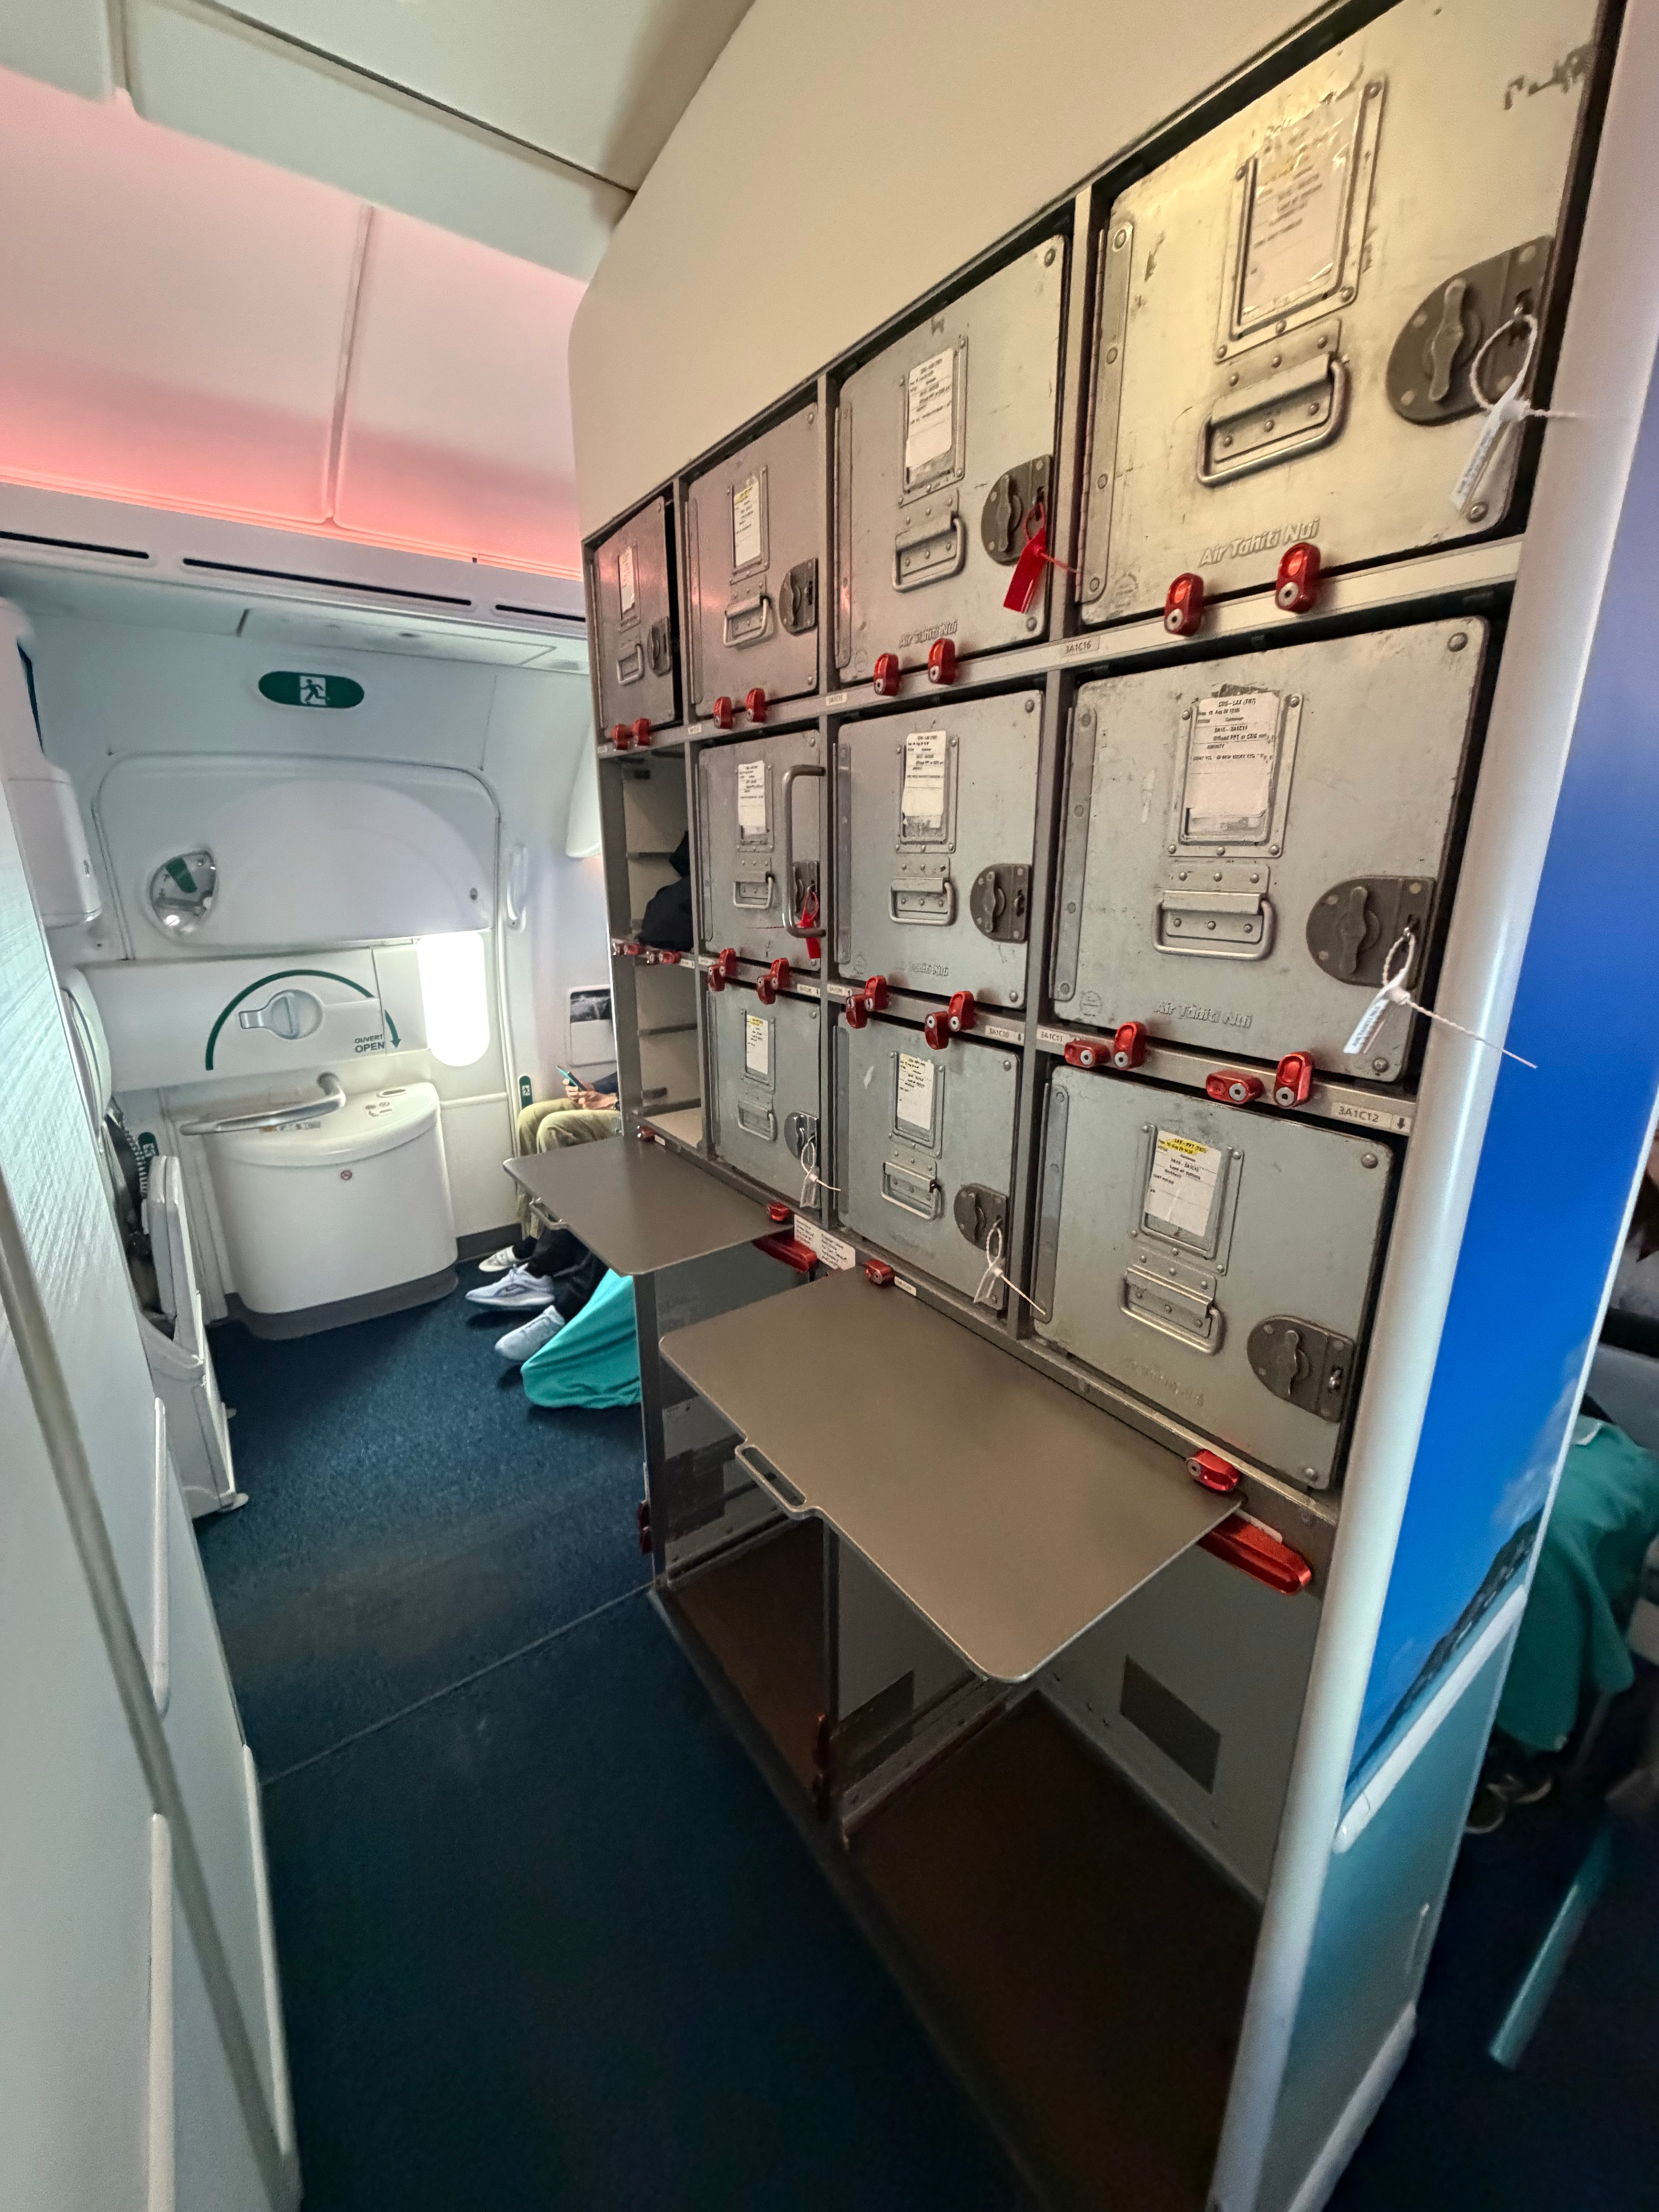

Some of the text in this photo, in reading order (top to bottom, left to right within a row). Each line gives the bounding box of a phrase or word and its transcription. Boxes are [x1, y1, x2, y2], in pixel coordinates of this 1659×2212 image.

[1198, 544, 1228, 568] Air
[1283, 516, 1320, 545] Nui
[355, 1034, 383, 1044] OUVERT
[355, 1041, 385, 1053] OPEN
[1338, 1106, 1379, 1122] 3A1C12
